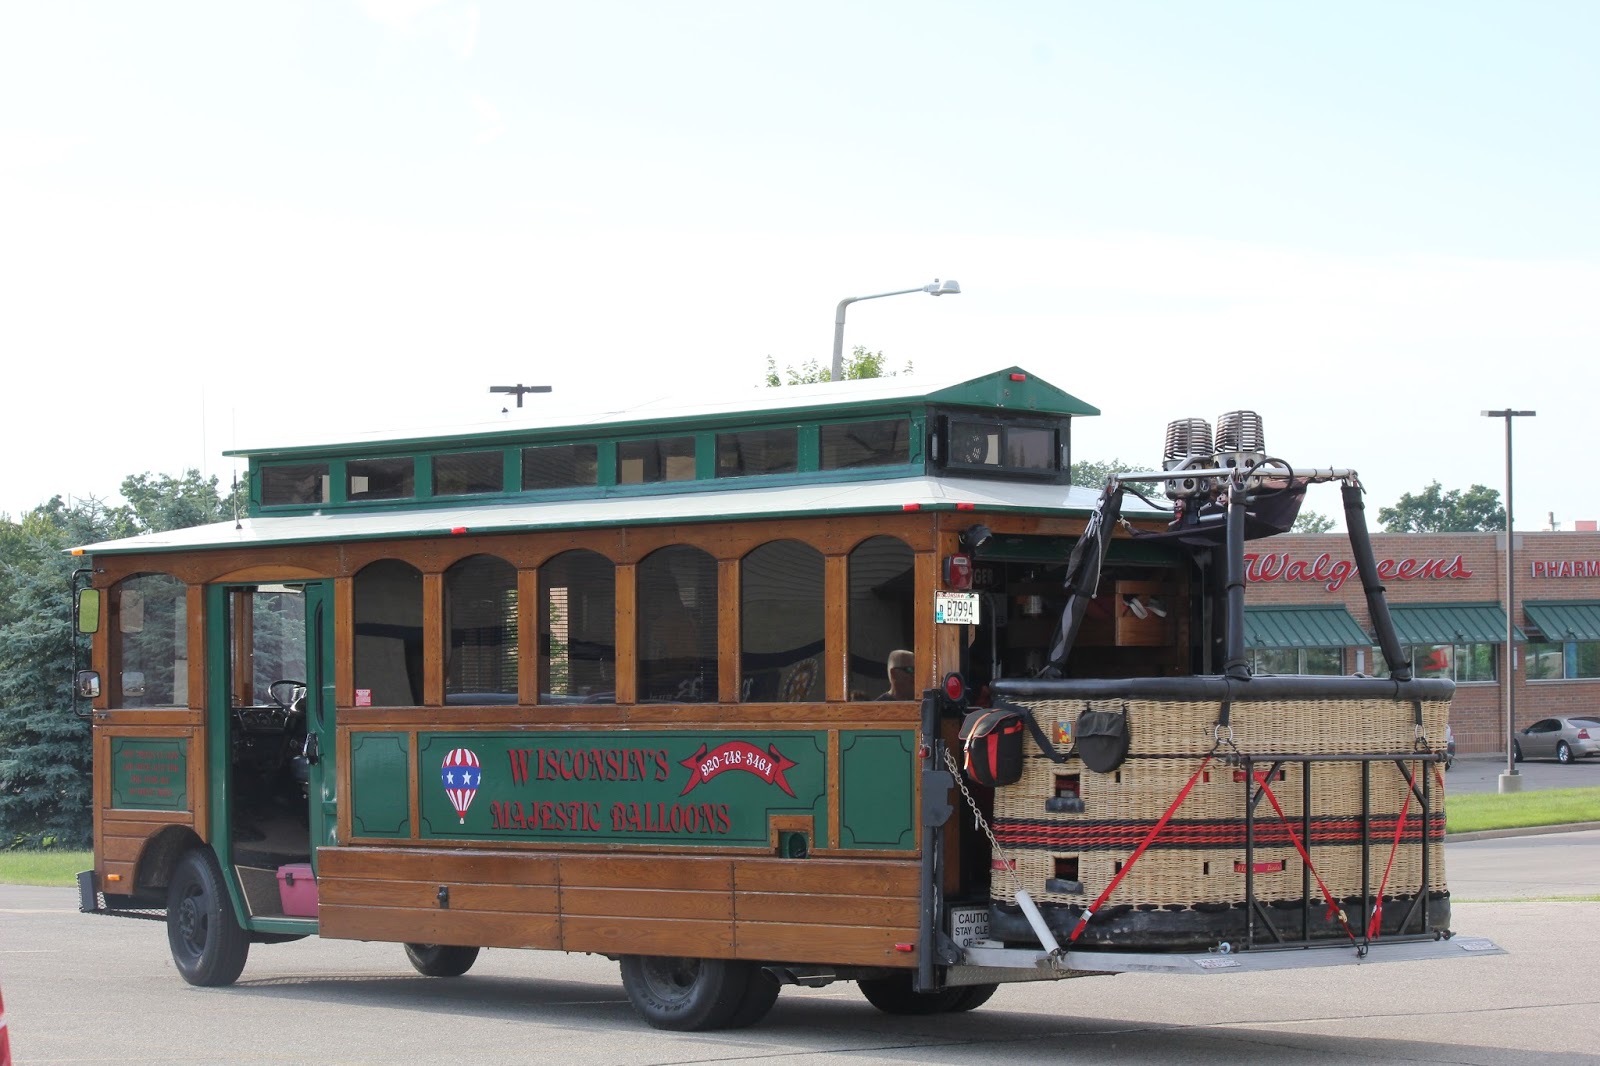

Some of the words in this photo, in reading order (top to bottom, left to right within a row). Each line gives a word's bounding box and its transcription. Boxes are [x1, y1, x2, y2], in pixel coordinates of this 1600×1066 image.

[972, 567, 993, 585] GER
[1244, 553, 1474, 592] Walgeens
[947, 600, 973, 617] B7994
[507, 749, 671, 786] WISCONSIN'S
[701, 750, 773, 777] 920-748-3464
[490, 801, 602, 831] MAJESTIC
[610, 802, 732, 834] BALLOONS
[955, 927, 972, 936] STAY
[962, 938, 973, 947] OF
